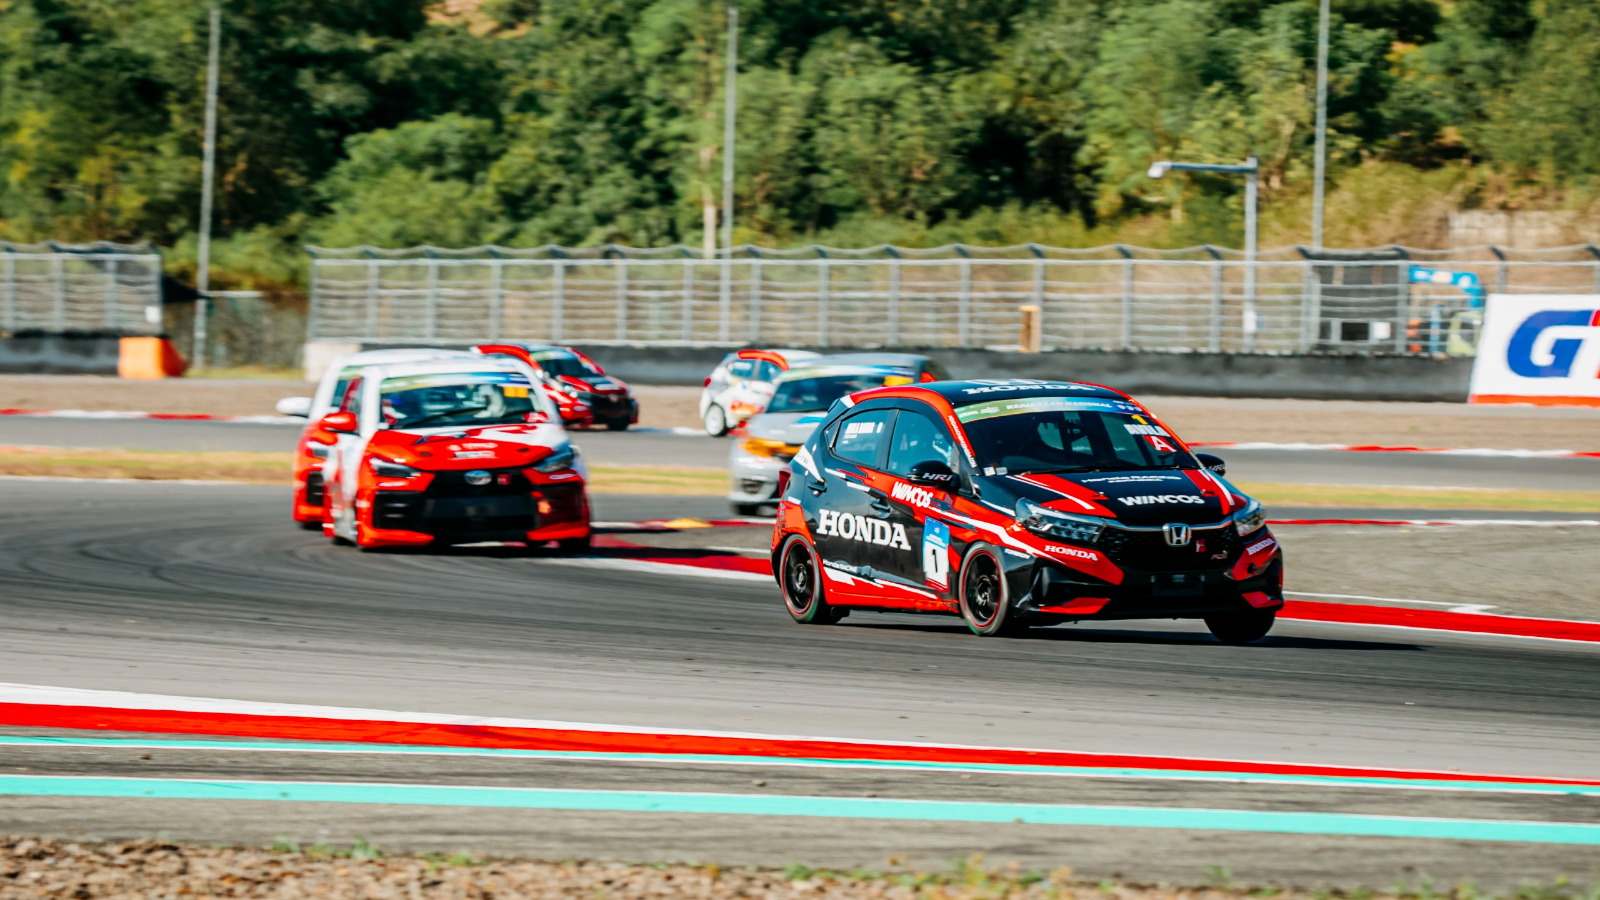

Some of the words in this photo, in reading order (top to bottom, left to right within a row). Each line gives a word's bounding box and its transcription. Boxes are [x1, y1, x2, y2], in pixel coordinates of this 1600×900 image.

[1507, 310, 1600, 378] G
[962, 384, 1096, 395] HONDA
[1131, 414, 1148, 425] 1
[1123, 424, 1171, 437] AVILA
[1151, 436, 1177, 452] A
[891, 481, 934, 508] WINCOS
[1117, 494, 1205, 506] WINCOS
[816, 508, 912, 551] HONDA
[931, 548, 939, 574] 1
[1044, 545, 1098, 561] HONDA
